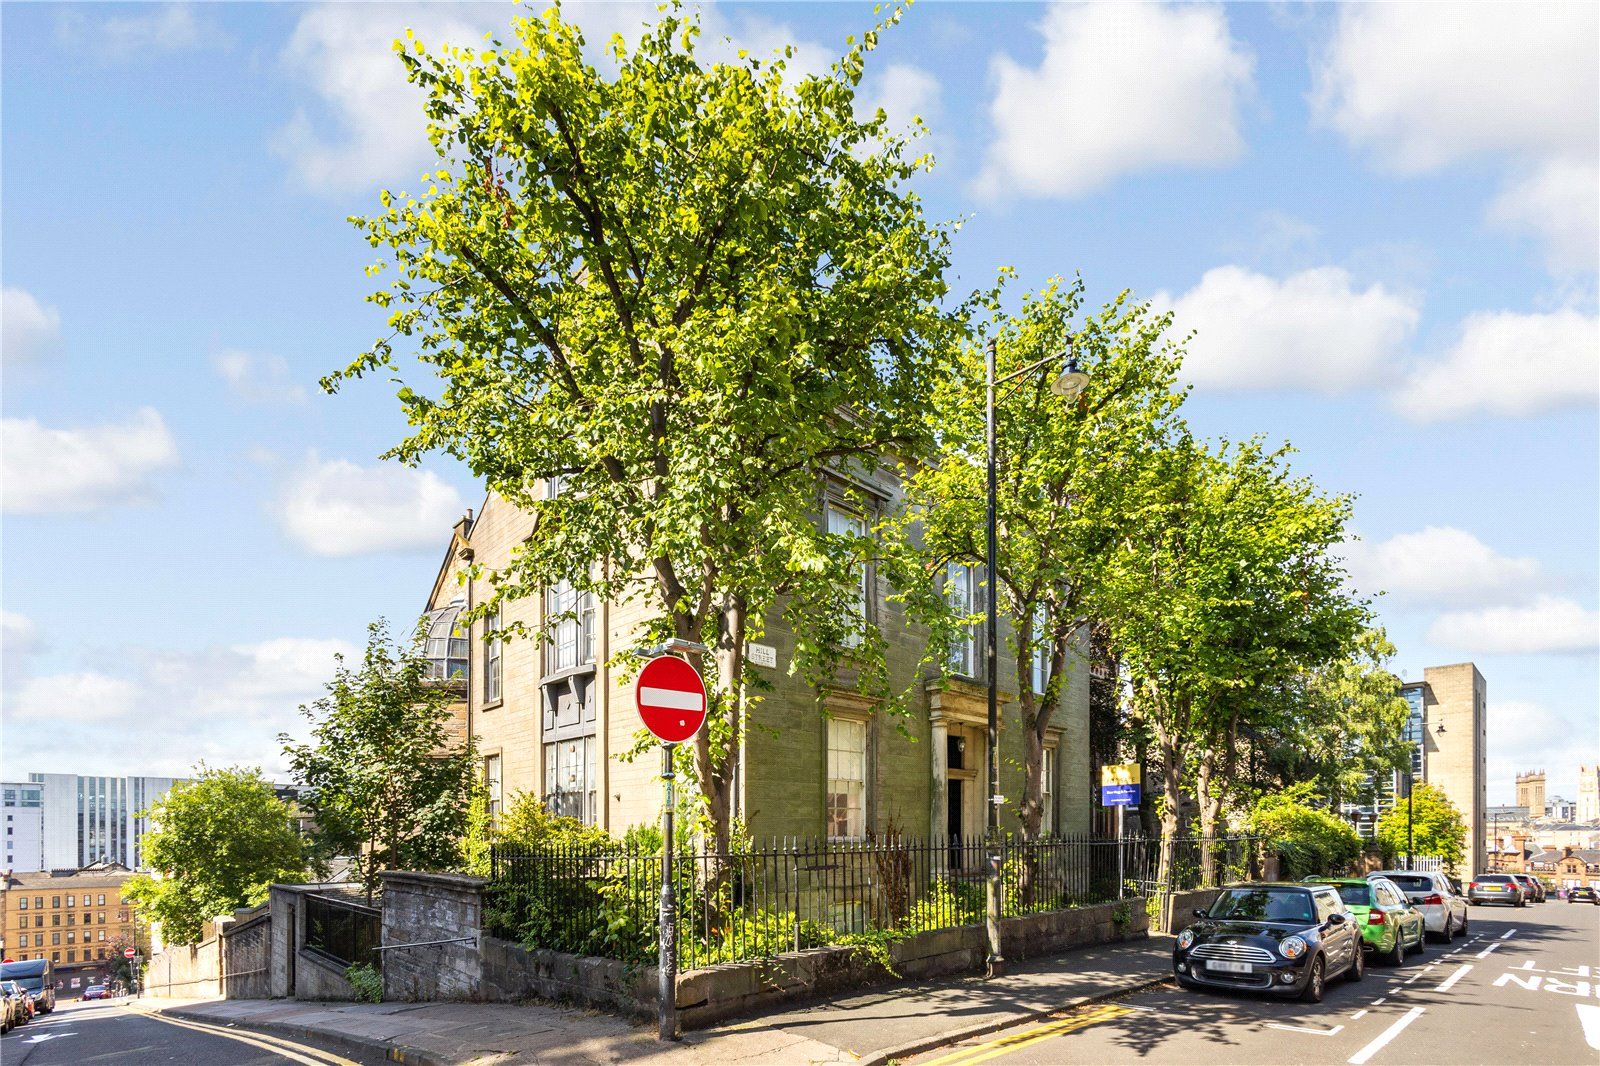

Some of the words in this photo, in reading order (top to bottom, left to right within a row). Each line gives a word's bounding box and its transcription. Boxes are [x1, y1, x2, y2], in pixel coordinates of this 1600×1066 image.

[755, 646, 770, 655] HILL
[751, 653, 774, 664] STREET
[1508, 960, 1600, 979] FT
[1492, 973, 1600, 999] RN
